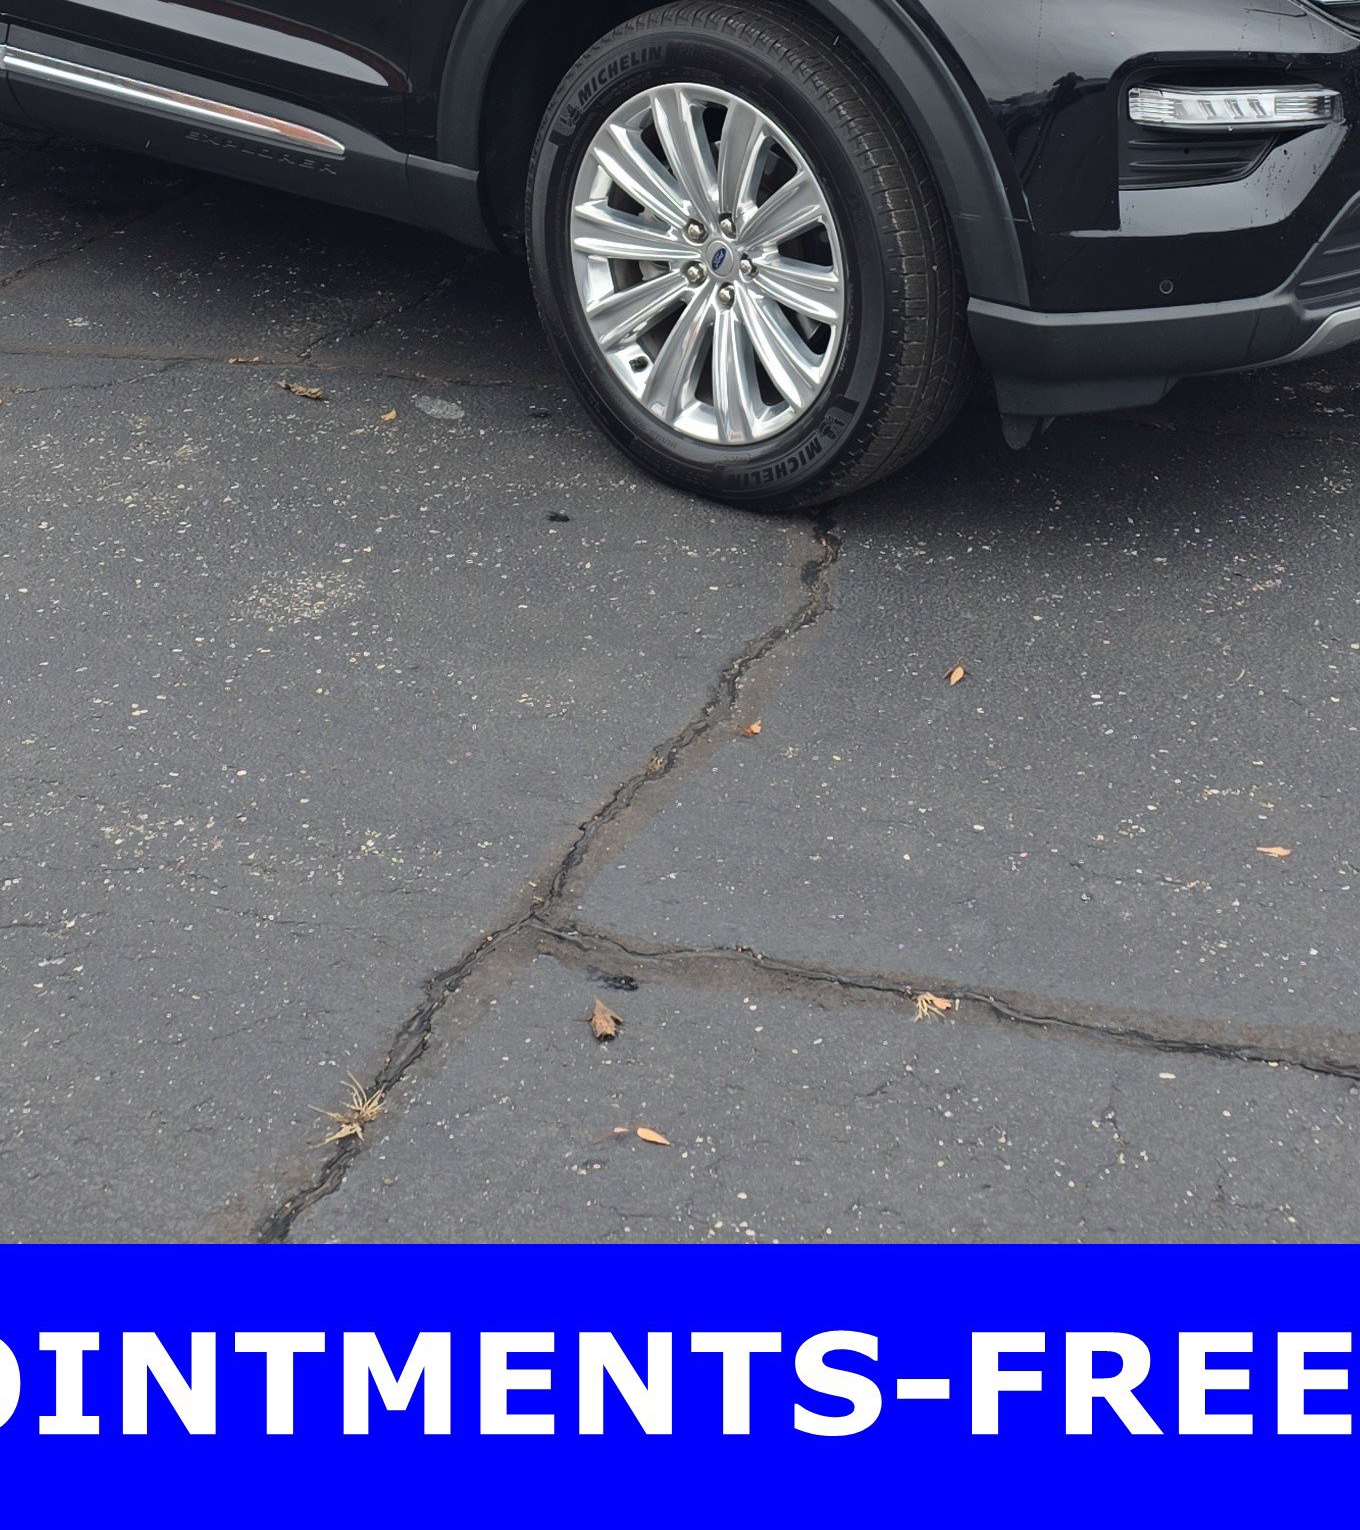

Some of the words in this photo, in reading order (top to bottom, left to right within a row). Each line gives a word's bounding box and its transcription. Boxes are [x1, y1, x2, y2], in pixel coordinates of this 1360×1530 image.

[577, 44, 663, 106] MICHELIN
[185, 131, 337, 176] EXPLORER
[727, 436, 823, 486] MICHELIN
